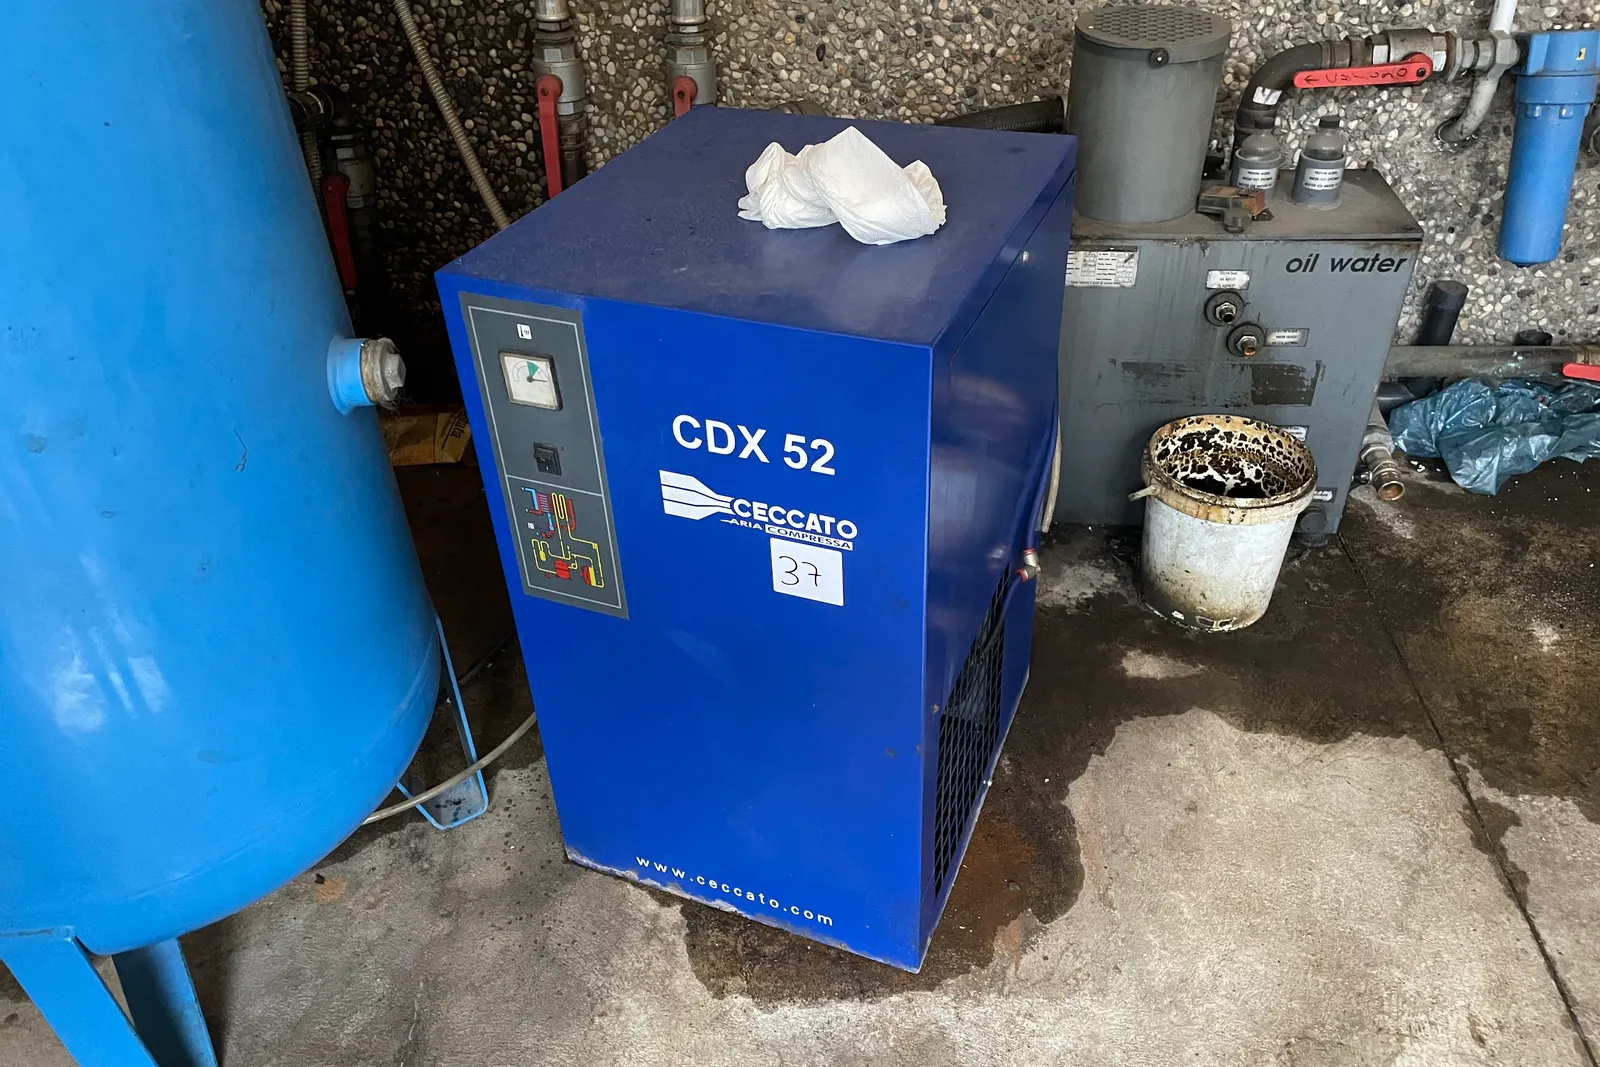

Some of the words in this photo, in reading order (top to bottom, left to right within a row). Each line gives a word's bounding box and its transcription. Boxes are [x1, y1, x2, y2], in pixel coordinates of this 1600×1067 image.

[1285, 253, 1320, 273] oil
[1330, 253, 1408, 273] water
[672, 414, 770, 464] CDX
[783, 433, 836, 476] 52
[726, 518, 763, 531] ARIA
[766, 525, 852, 550] COMPRESSA
[733, 498, 858, 540] CECCATO
[779, 555, 822, 587] 37
[636, 855, 834, 927] www.ceccato.com
